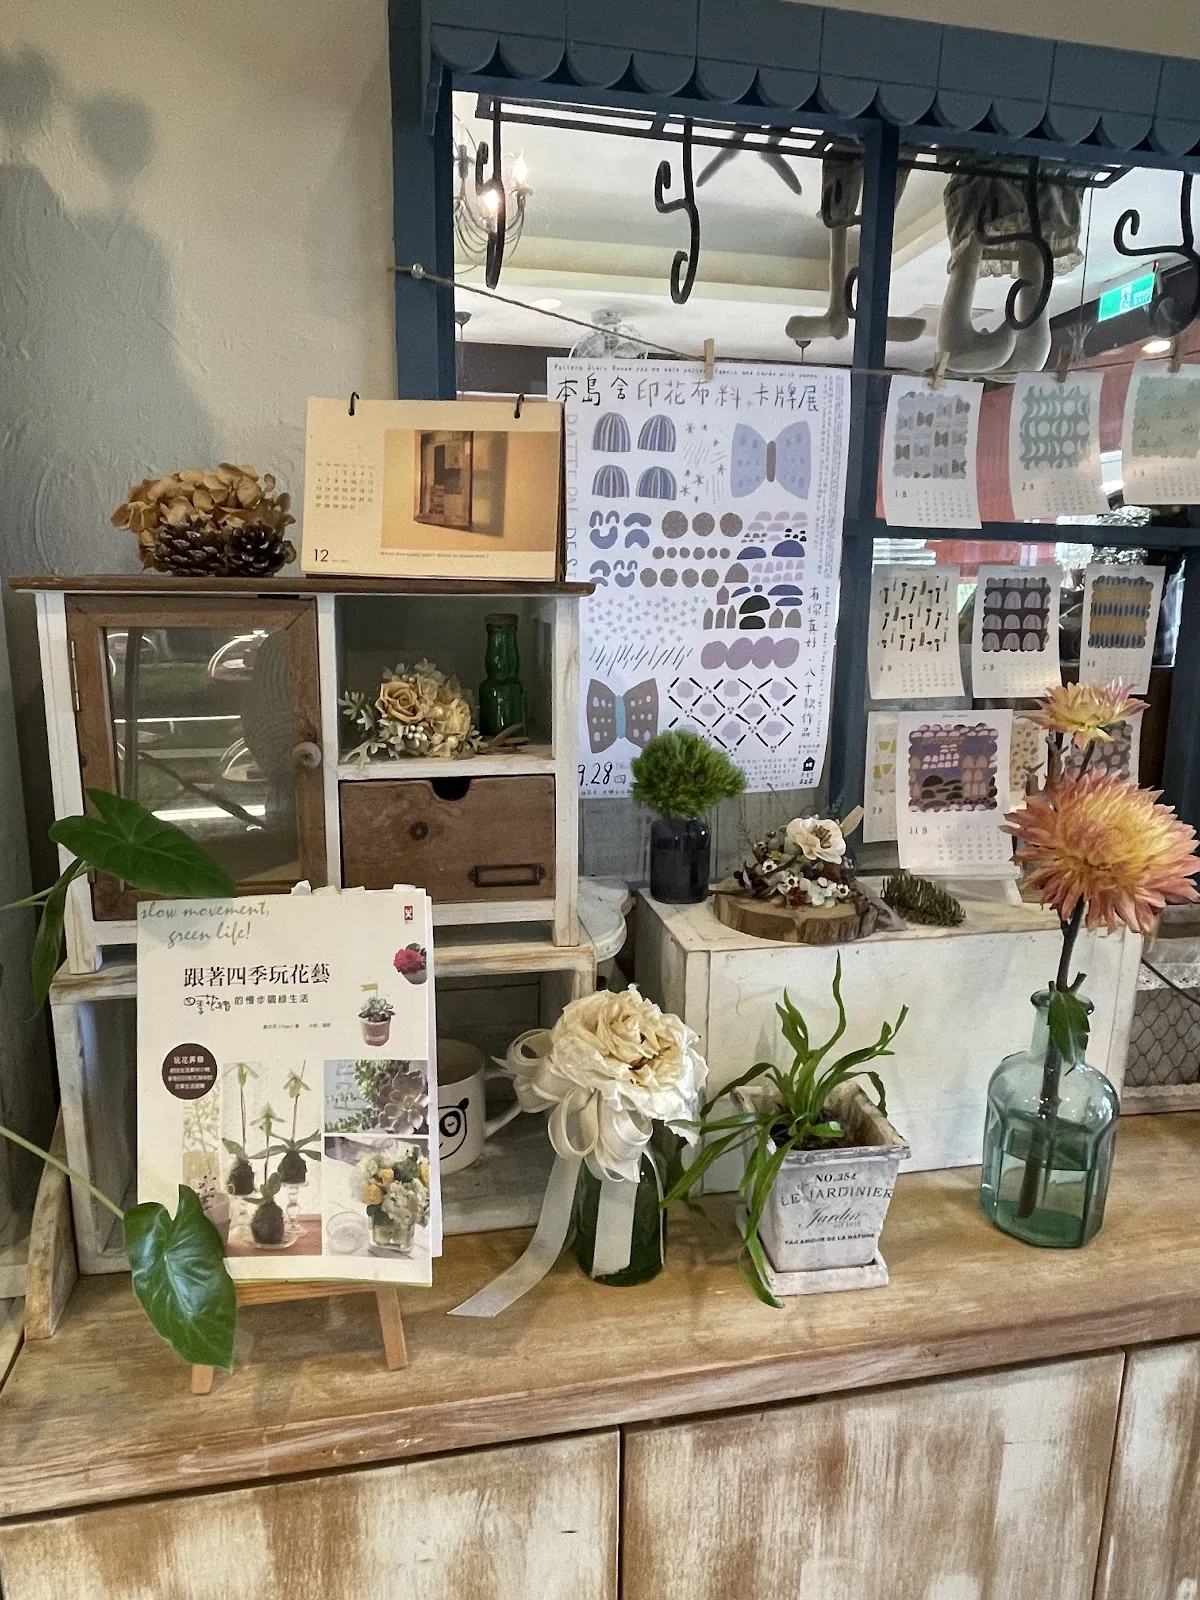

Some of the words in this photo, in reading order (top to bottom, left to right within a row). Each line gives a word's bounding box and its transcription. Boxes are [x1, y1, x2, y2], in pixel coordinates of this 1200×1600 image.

[314, 549, 329, 563] 12
[139, 901, 177, 919] slow
[167, 929, 211, 949] green
[216, 921, 251, 946] life!
[184, 963, 330, 988] 跟著四季玩花藝
